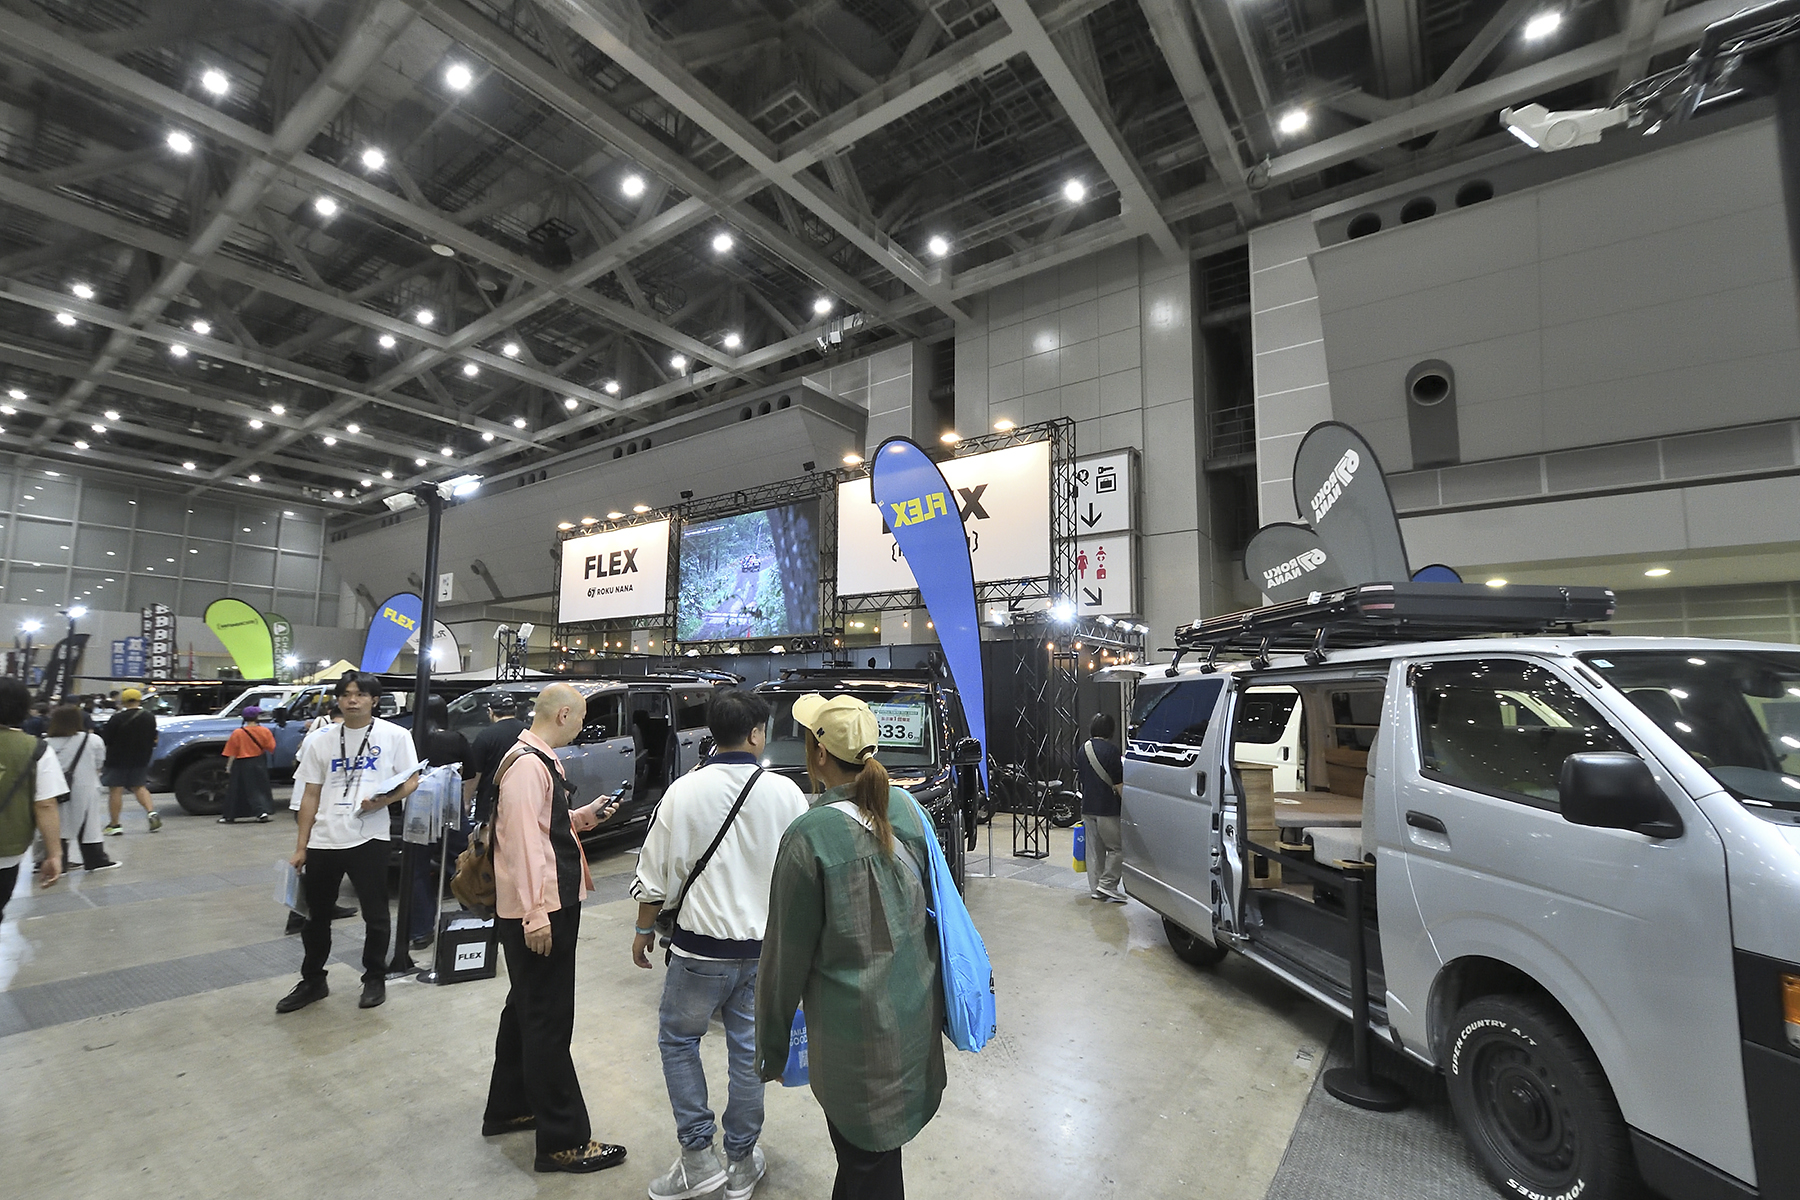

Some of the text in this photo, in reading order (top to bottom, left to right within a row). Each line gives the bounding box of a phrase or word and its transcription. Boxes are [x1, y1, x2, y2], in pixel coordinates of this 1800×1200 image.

[584, 547, 639, 580] FLEX
[597, 586, 614, 596] ROKU
[615, 584, 633, 593] NANA
[383, 607, 416, 631] FLEX
[331, 756, 378, 773] FLEX
[458, 951, 482, 960] FLEX
[1452, 1019, 1538, 1075] OPEN COUNTRY A/T
